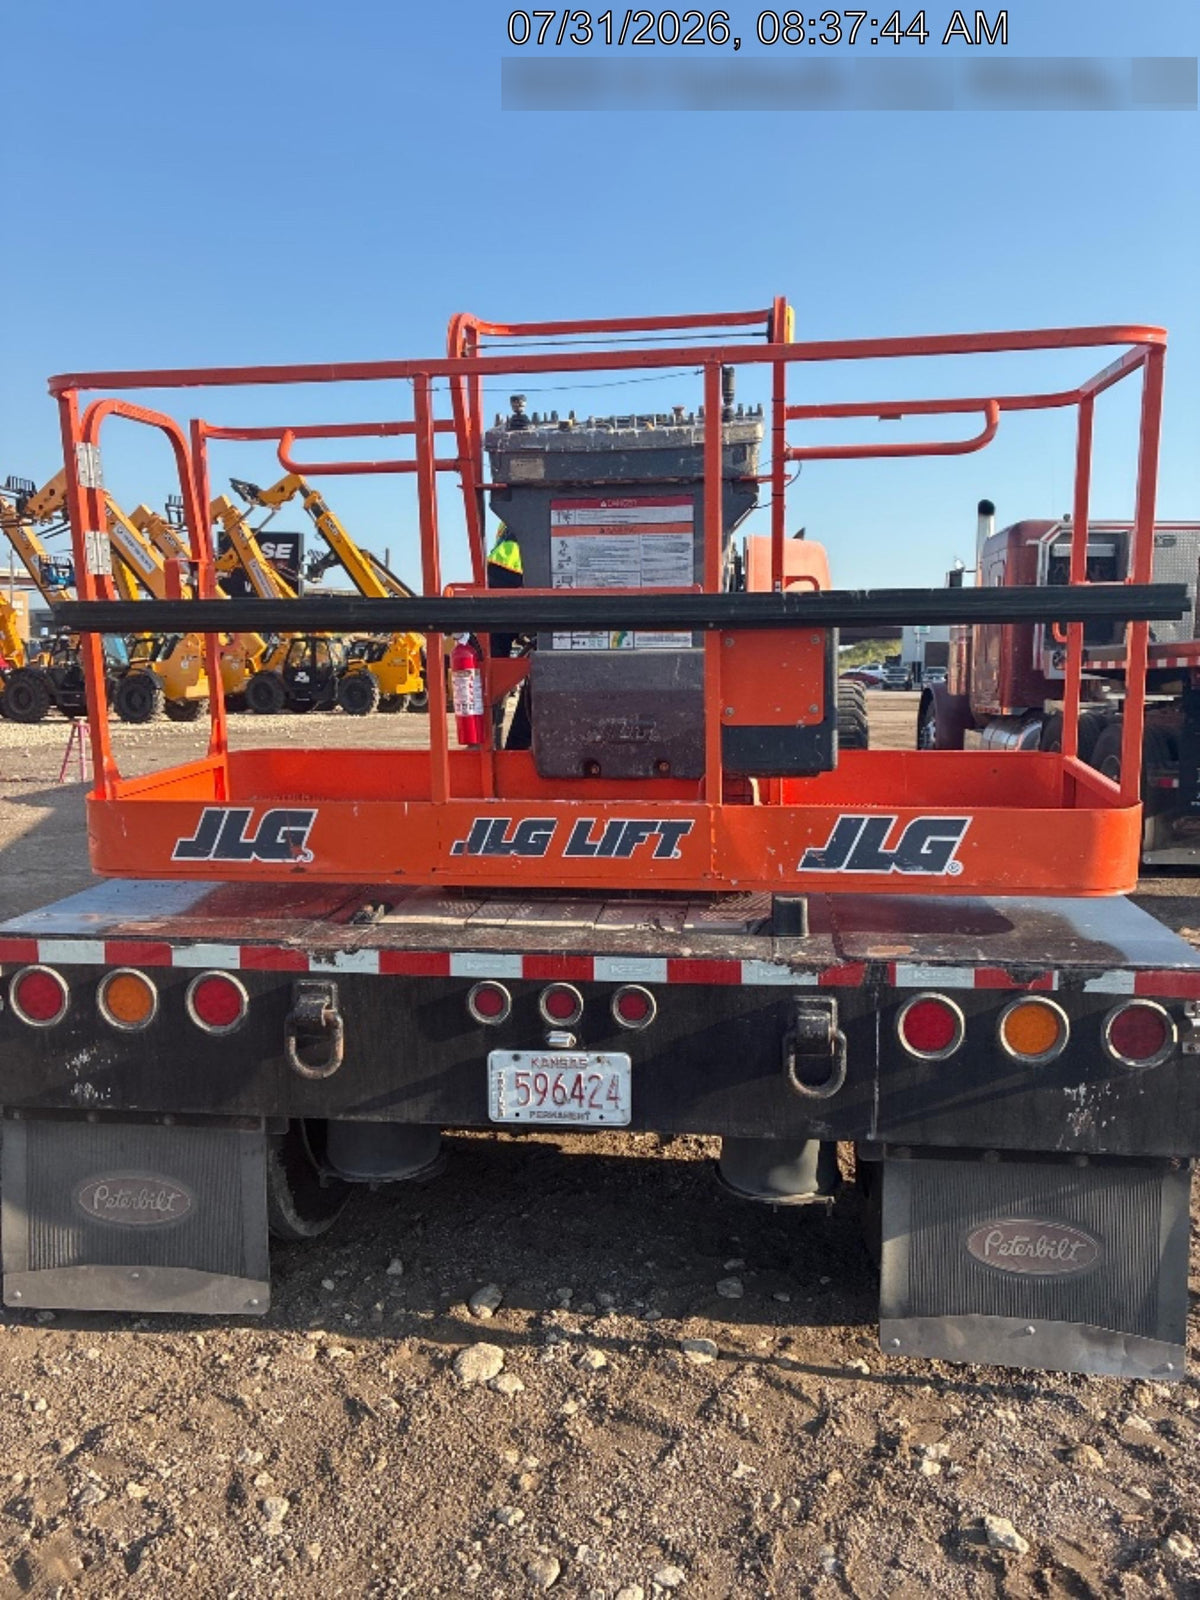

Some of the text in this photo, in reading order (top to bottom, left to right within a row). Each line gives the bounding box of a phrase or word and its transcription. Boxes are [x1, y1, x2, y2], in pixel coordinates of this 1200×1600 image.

[170, 806, 319, 863] JLG
[450, 817, 696, 859] JLG LIFT
[796, 814, 973, 875] JLG
[531, 1056, 589, 1070] KANSAS
[514, 1071, 621, 1110] 596424
[529, 1110, 591, 1121] PERMANENT
[93, 1185, 181, 1212] Peterbilt
[984, 1230, 1087, 1261] Peterbilt
